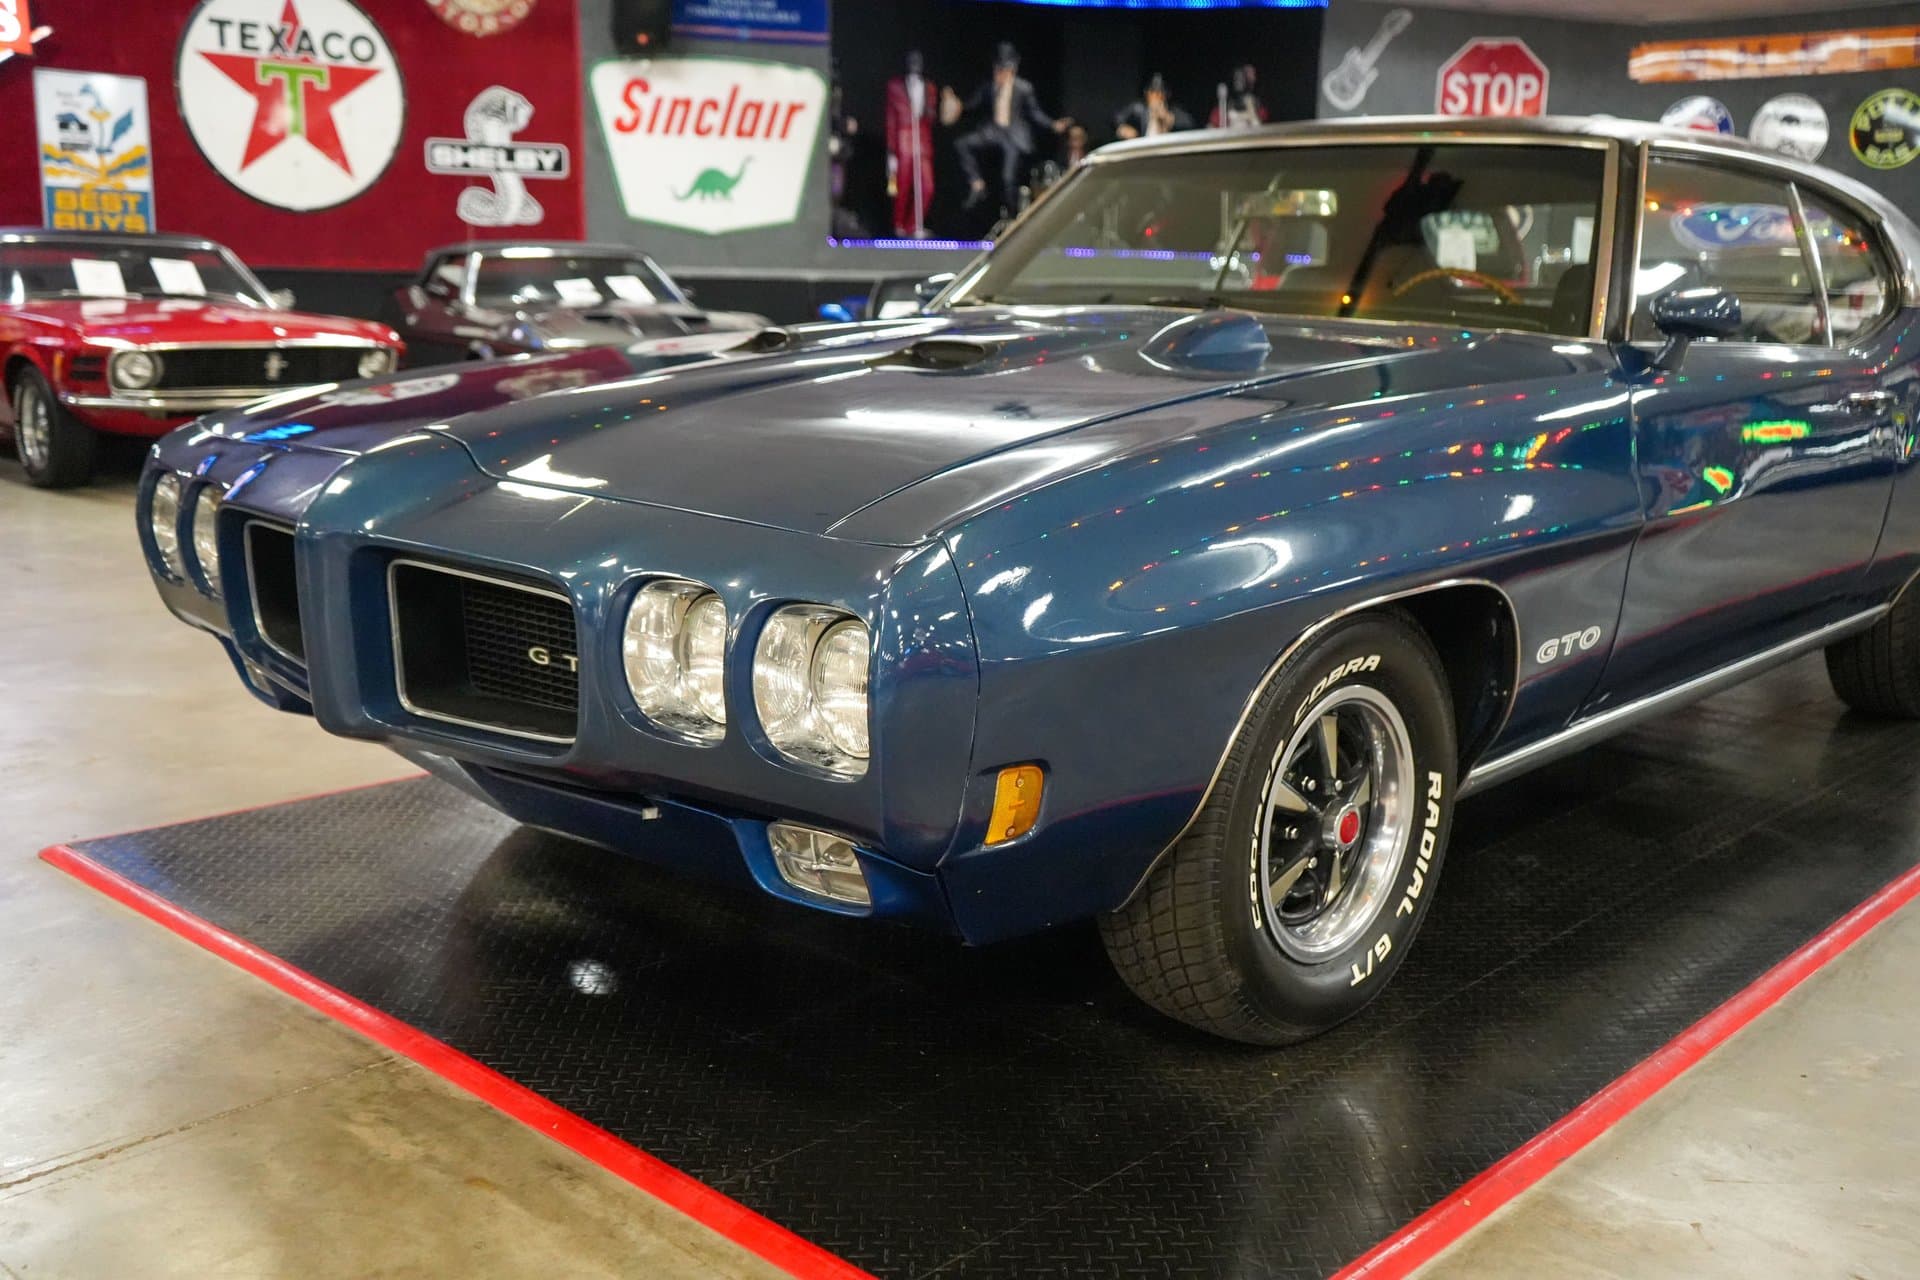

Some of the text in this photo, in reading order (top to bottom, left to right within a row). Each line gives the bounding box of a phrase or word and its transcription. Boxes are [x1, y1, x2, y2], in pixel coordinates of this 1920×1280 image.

[208, 18, 376, 63] TEXACO
[257, 60, 329, 136] T
[614, 76, 806, 140] Sinclair
[1444, 72, 1540, 117] STOP
[431, 144, 561, 172] SHELBY
[53, 210, 148, 234] BUYS
[54, 188, 142, 215] BEST
[1536, 625, 1601, 664] GTO
[1293, 655, 1381, 727] COBRA
[1350, 771, 1442, 987] RADIAL G/T
